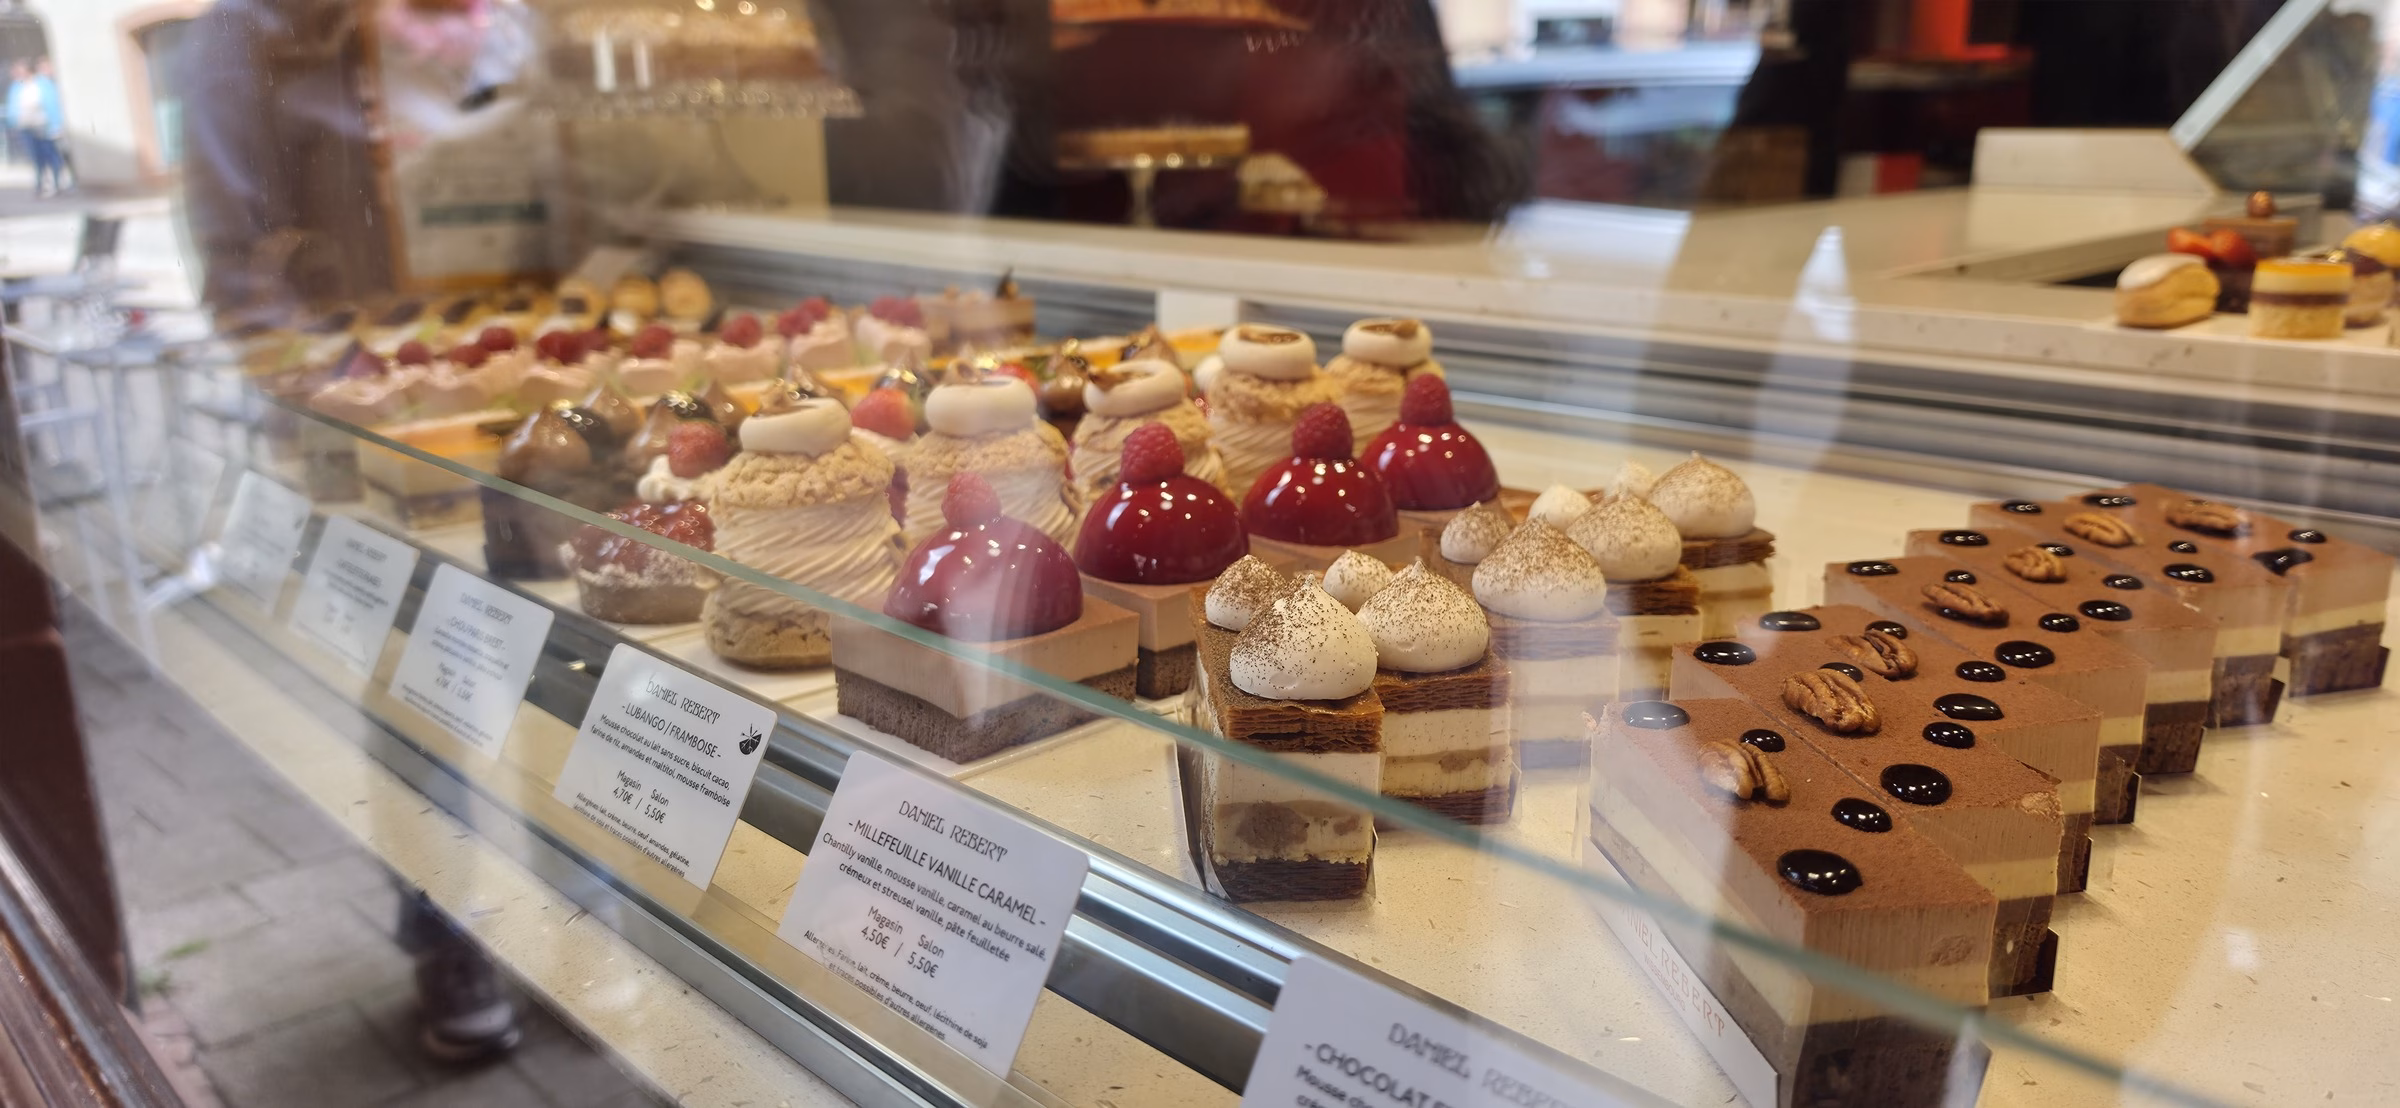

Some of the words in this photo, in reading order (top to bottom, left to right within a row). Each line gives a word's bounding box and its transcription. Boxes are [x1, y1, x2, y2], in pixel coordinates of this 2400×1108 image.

[626, 703, 665, 731] LUBANGO
[669, 725, 717, 757] FRAMBOISE
[646, 681, 678, 704] DANIEL
[680, 697, 720, 725] REBERT
[590, 725, 605, 738] farine
[604, 732, 613, 743] de
[612, 737, 622, 748] riz,
[621, 742, 645, 759] amandes
[644, 755, 652, 764] et
[652, 758, 676, 777] maltitol,
[676, 773, 698, 789] mousse
[699, 784, 730, 806] framboise
[600, 714, 620, 730] Mousse
[620, 725, 643, 742] chocolat
[643, 738, 651, 747] au
[651, 741, 660, 751] lait
[661, 748, 673, 758] sans
[673, 755, 691, 769] sucre,
[691, 762, 711, 778] biscuit
[711, 774, 730, 789] cacao,
[613, 785, 632, 804] 4,70€
[644, 804, 665, 824] 5,50€
[616, 770, 641, 793] Magasin
[650, 789, 669, 806] Salon
[899, 800, 947, 834] DANIEL
[949, 824, 1007, 863] REBERT
[821, 832, 856, 859] Chantilly
[856, 851, 884, 873] vanille,
[885, 868, 915, 889] mousse
[916, 883, 946, 907] vanille,
[947, 899, 981, 925] caramel
[981, 919, 994, 932] au
[994, 924, 1025, 948] beurre
[1025, 940, 1048, 961] salé,
[854, 820, 927, 866] MILLEFEUILLE
[926, 856, 977, 892] VANILLE
[977, 882, 1039, 924] CARAMEL
[839, 861, 871, 885] crémeux
[871, 879, 882, 891] et
[881, 884, 915, 909] streusel
[915, 902, 945, 927] vanille,
[945, 920, 965, 939] pâte
[966, 930, 1010, 962] feuilletée
[866, 906, 904, 938] Magasin
[917, 934, 945, 958] Salon
[828, 961, 837, 971] et
[855, 977, 884, 1001] possibles
[860, 923, 889, 950] 4,50€
[907, 951, 938, 979] 5,50€
[891, 983, 915, 1004] beurre,
[933, 1008, 963, 1033] lécithine
[963, 1026, 974, 1040] de
[972, 1034, 988, 1050] soja
[1661, 947, 1725, 1038] REBERT
[1316, 1043, 1431, 1108] CHOCOLAT
[1388, 1022, 1471, 1079] DANIEL
[1296, 1065, 1346, 1101] Mousse
